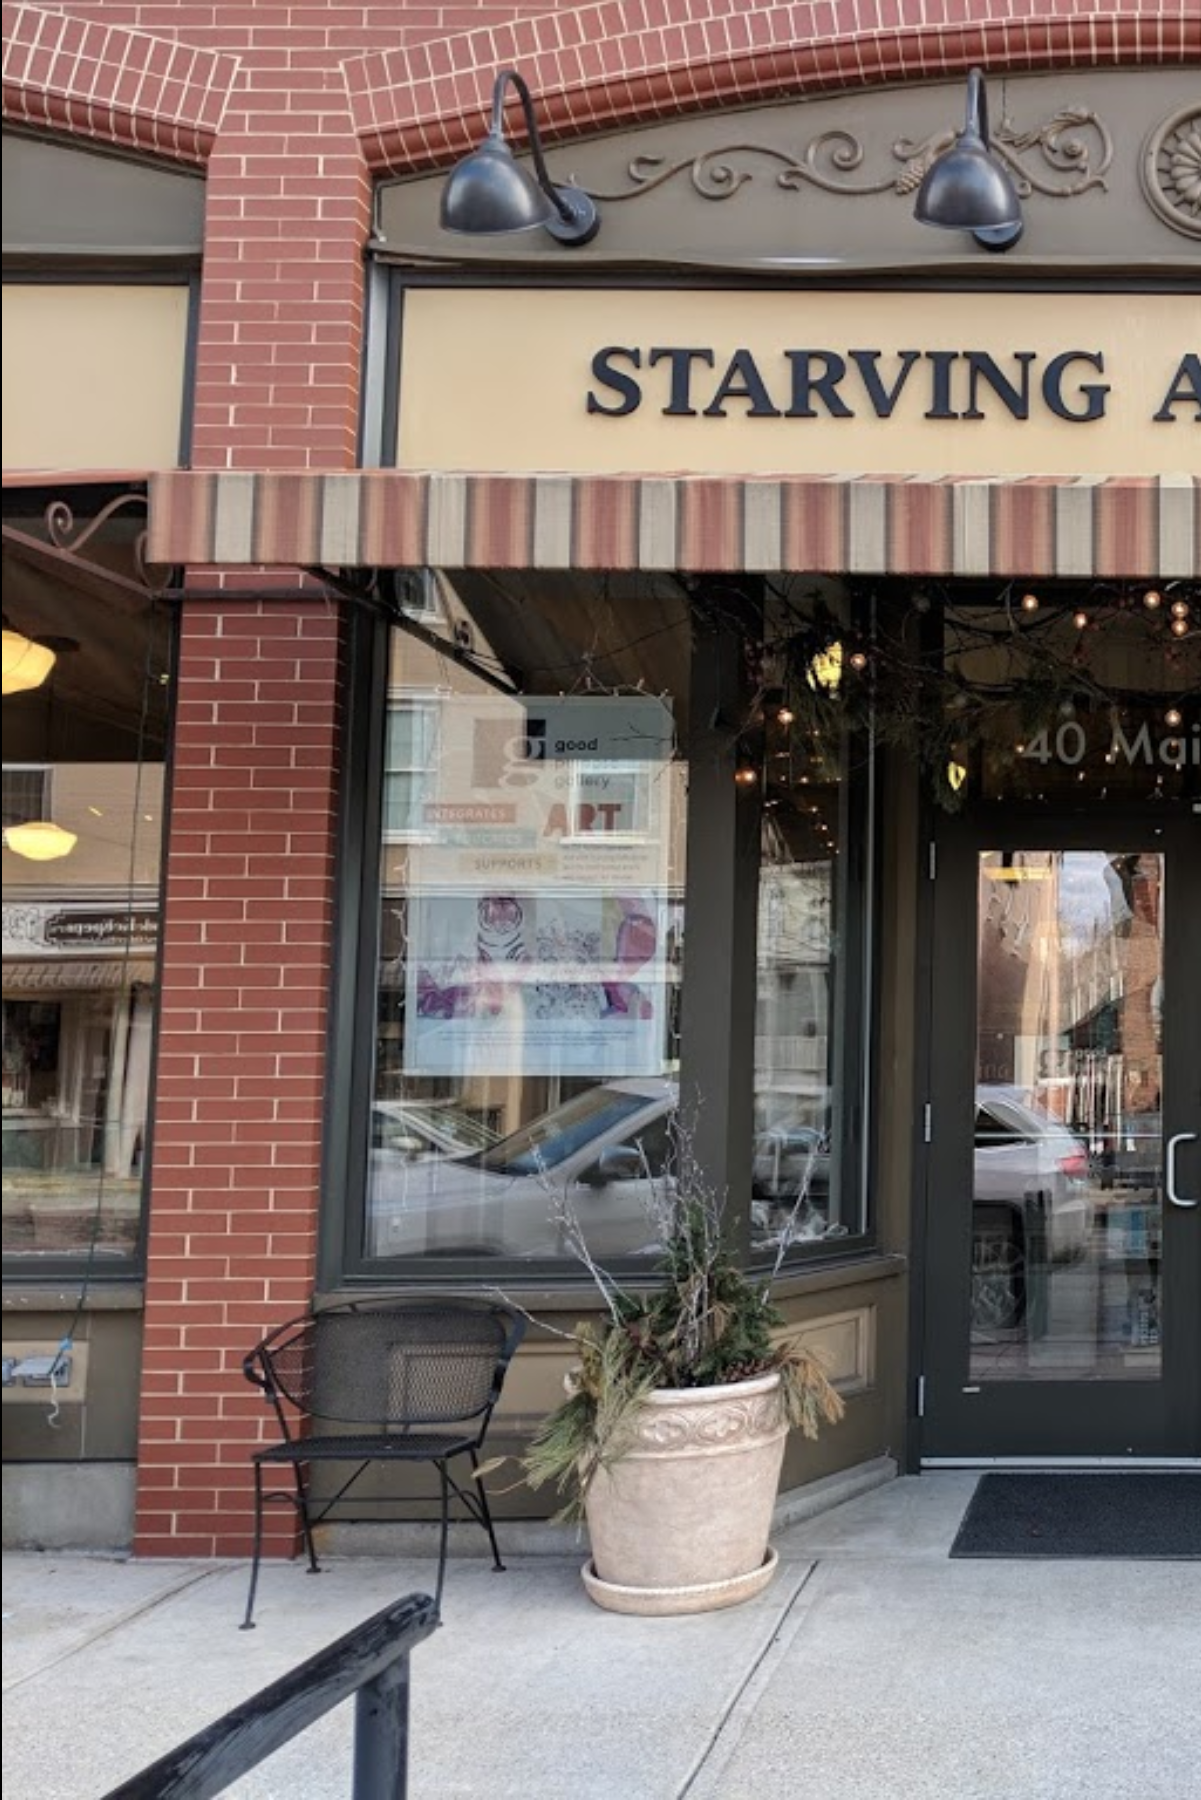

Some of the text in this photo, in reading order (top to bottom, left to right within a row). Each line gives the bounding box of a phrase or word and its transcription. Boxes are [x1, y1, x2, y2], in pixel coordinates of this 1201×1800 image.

[586, 346, 1111, 423] STARVING
[555, 738, 598, 753] good
[1024, 721, 1086, 765] 40
[543, 803, 622, 836] ART
[474, 858, 541, 870] SUPPORTS
